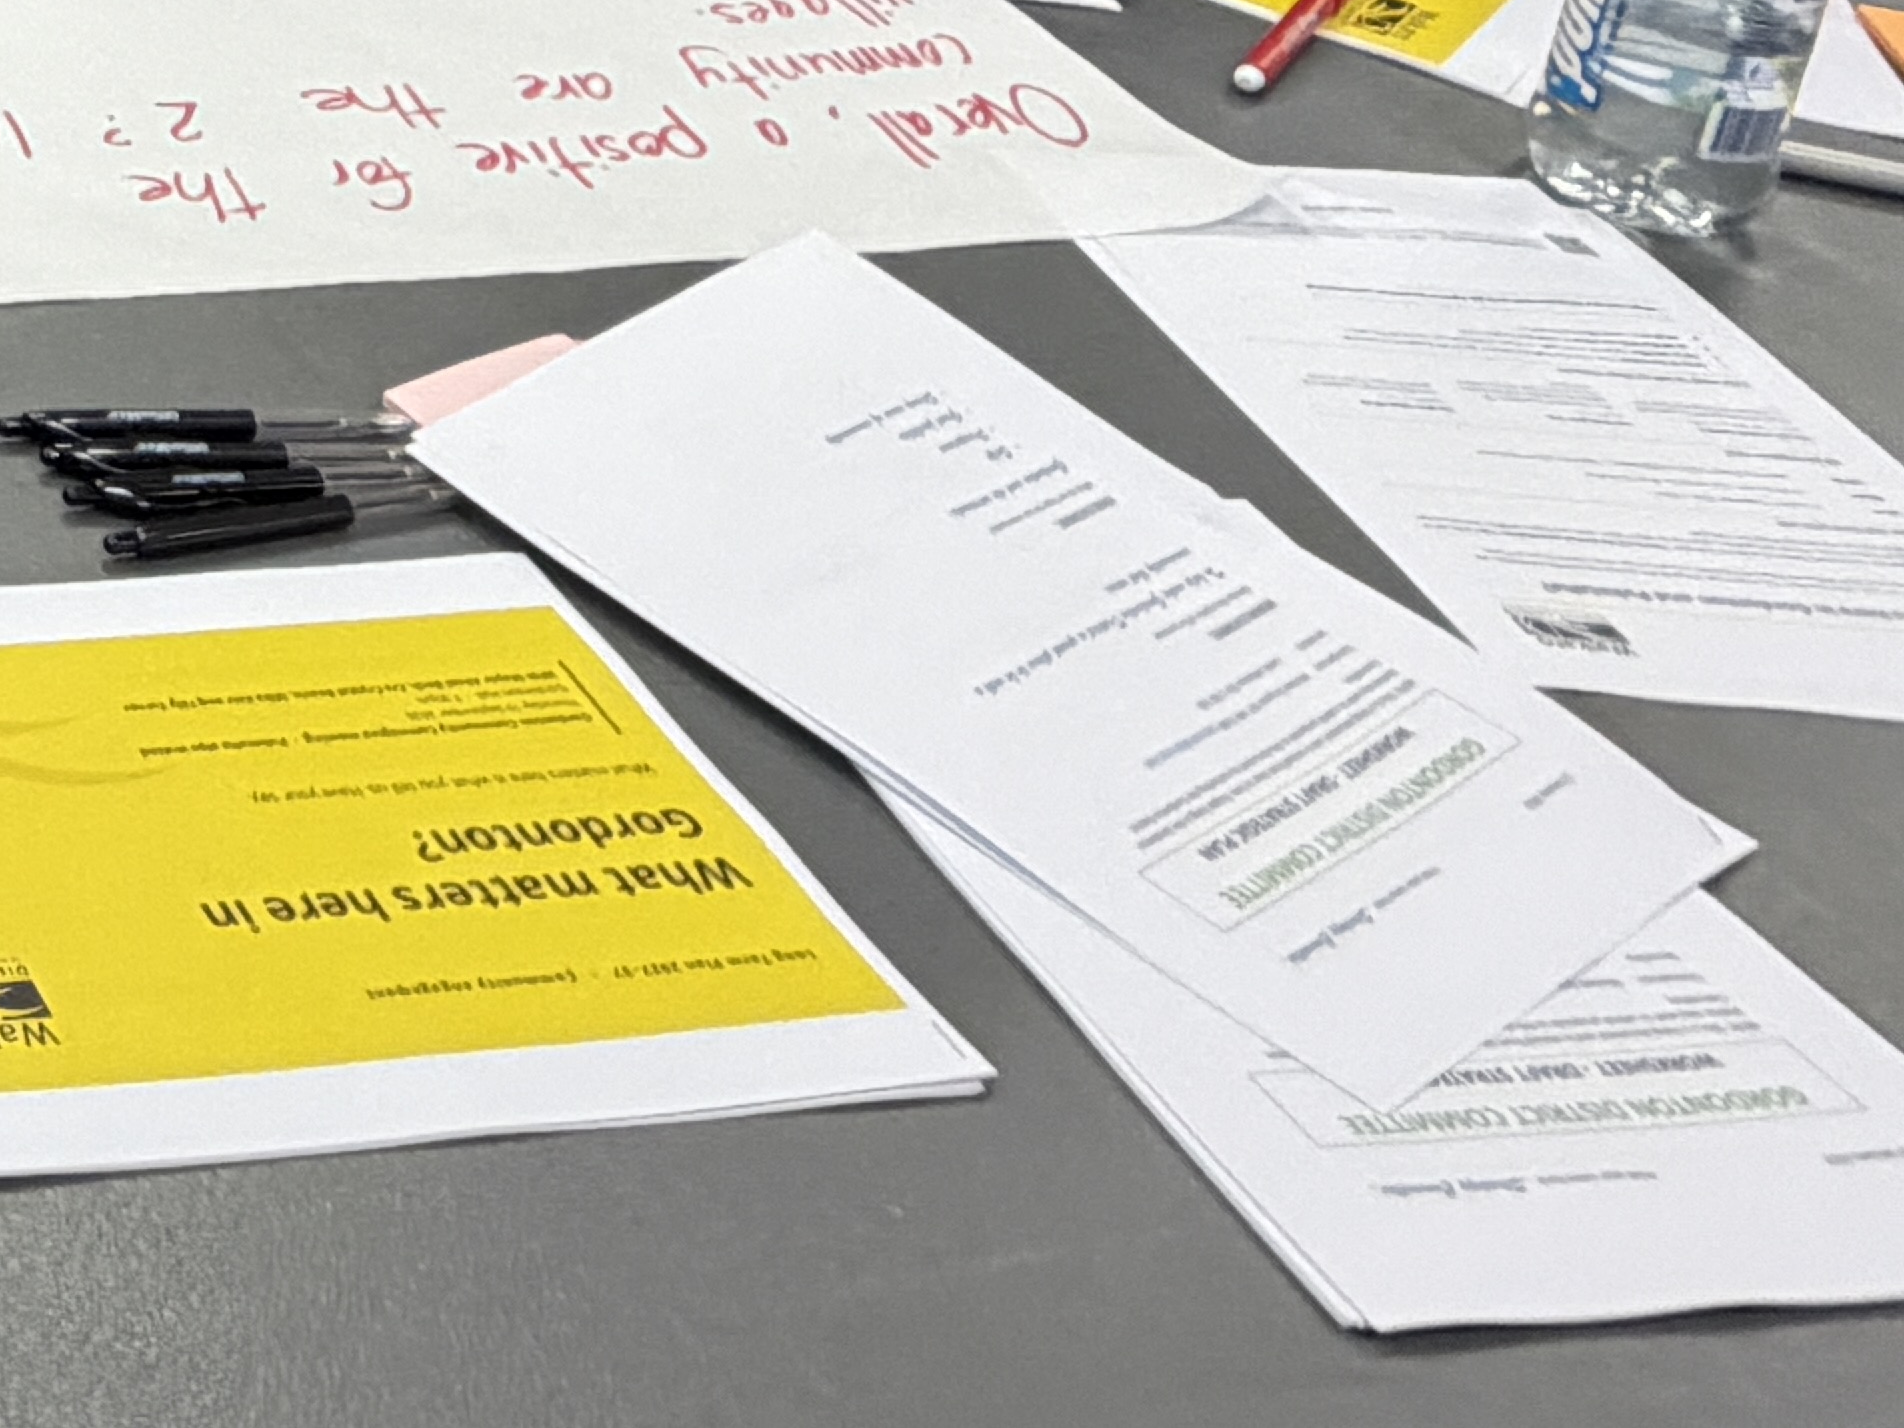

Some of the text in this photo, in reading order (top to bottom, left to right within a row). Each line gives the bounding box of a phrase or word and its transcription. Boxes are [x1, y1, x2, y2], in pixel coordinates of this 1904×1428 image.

[513, 72, 612, 103] are
[678, 33, 971, 100] community
[301, 83, 443, 129] the
[753, 118, 788, 147] a
[456, 106, 707, 190] positive
[128, 167, 266, 222] the
[333, 157, 412, 211] for
[411, 807, 703, 864] Gordonton?
[200, 856, 753, 934] What matters here in
